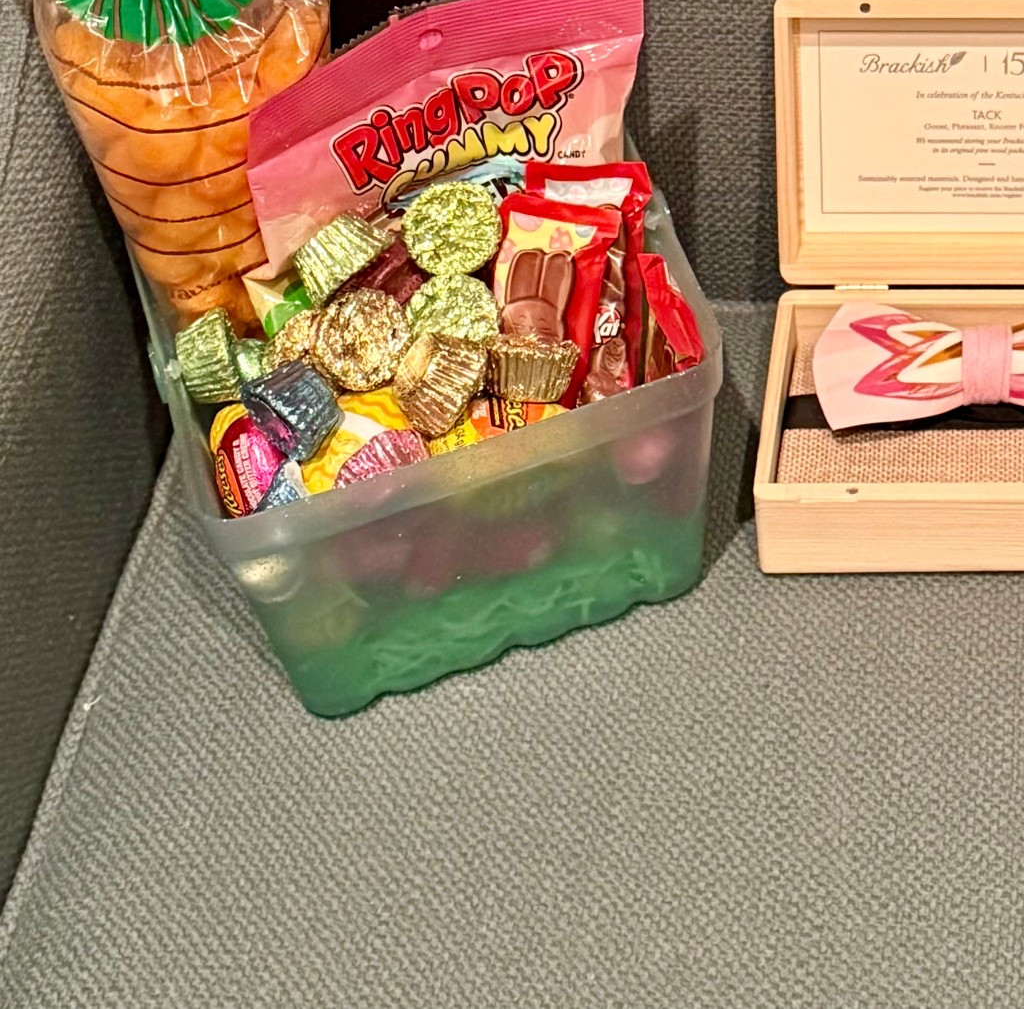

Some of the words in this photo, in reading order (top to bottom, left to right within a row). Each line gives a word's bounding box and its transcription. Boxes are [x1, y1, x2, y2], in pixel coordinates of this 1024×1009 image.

[860, 52, 952, 74] Brackish
[916, 91, 925, 99] In
[926, 91, 968, 99] celebration
[970, 90, 979, 101] of
[981, 91, 993, 99] the
[972, 110, 1002, 120] TACK
[333, 88, 460, 190] Ring
[557, 150, 586, 159] CANDY
